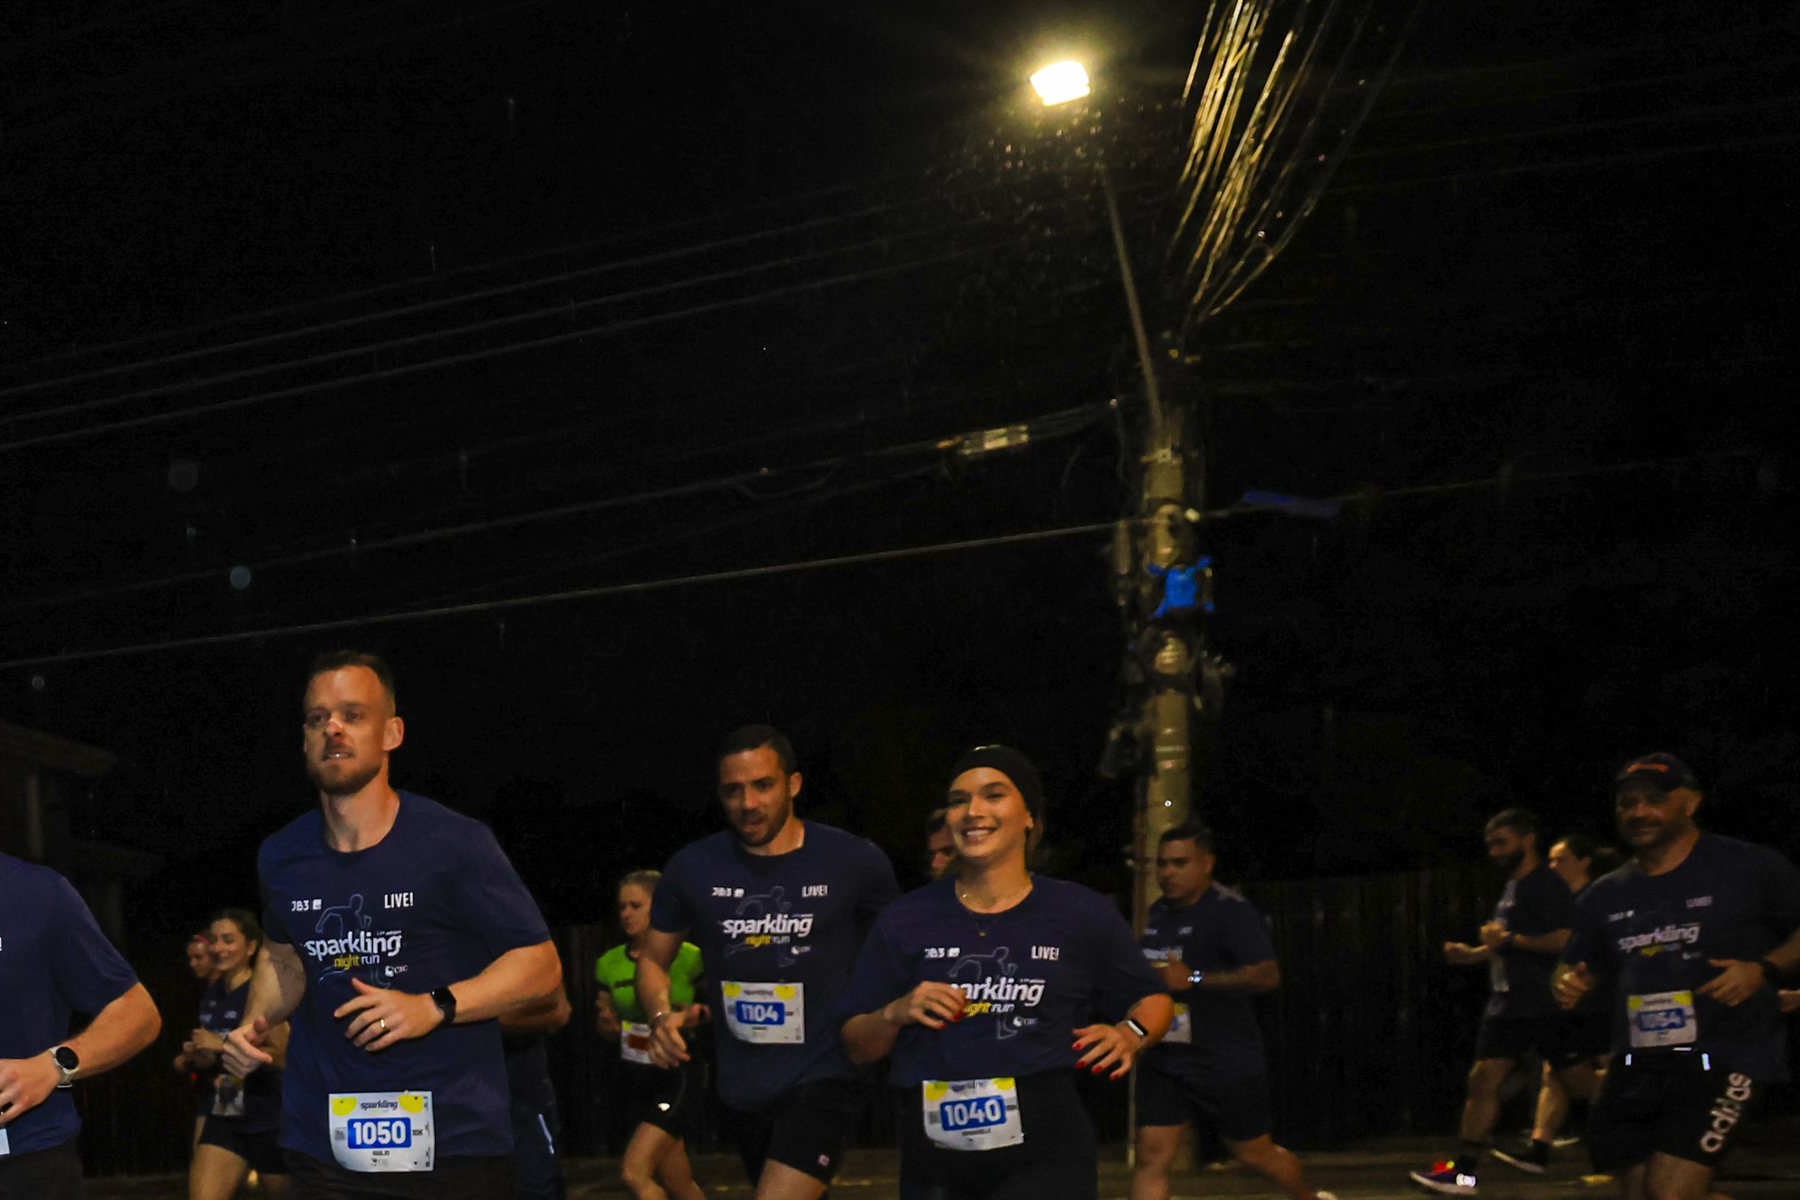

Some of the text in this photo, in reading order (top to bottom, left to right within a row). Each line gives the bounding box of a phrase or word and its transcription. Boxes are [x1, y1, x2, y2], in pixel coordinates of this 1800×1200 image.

[291, 900, 309, 911] JB3
[384, 892, 413, 909] LIVE!
[722, 913, 813, 939] sparkling
[305, 931, 402, 961] sparkling
[1031, 945, 1059, 960] LIVE!
[334, 955, 380, 971] night run
[741, 1004, 779, 1022] 1104
[991, 1003, 1015, 1013] run
[360, 1099, 398, 1111] sparkling
[944, 1098, 1001, 1126] 1040
[1700, 1073, 1751, 1152] adidas
[353, 1120, 406, 1145] 1050
